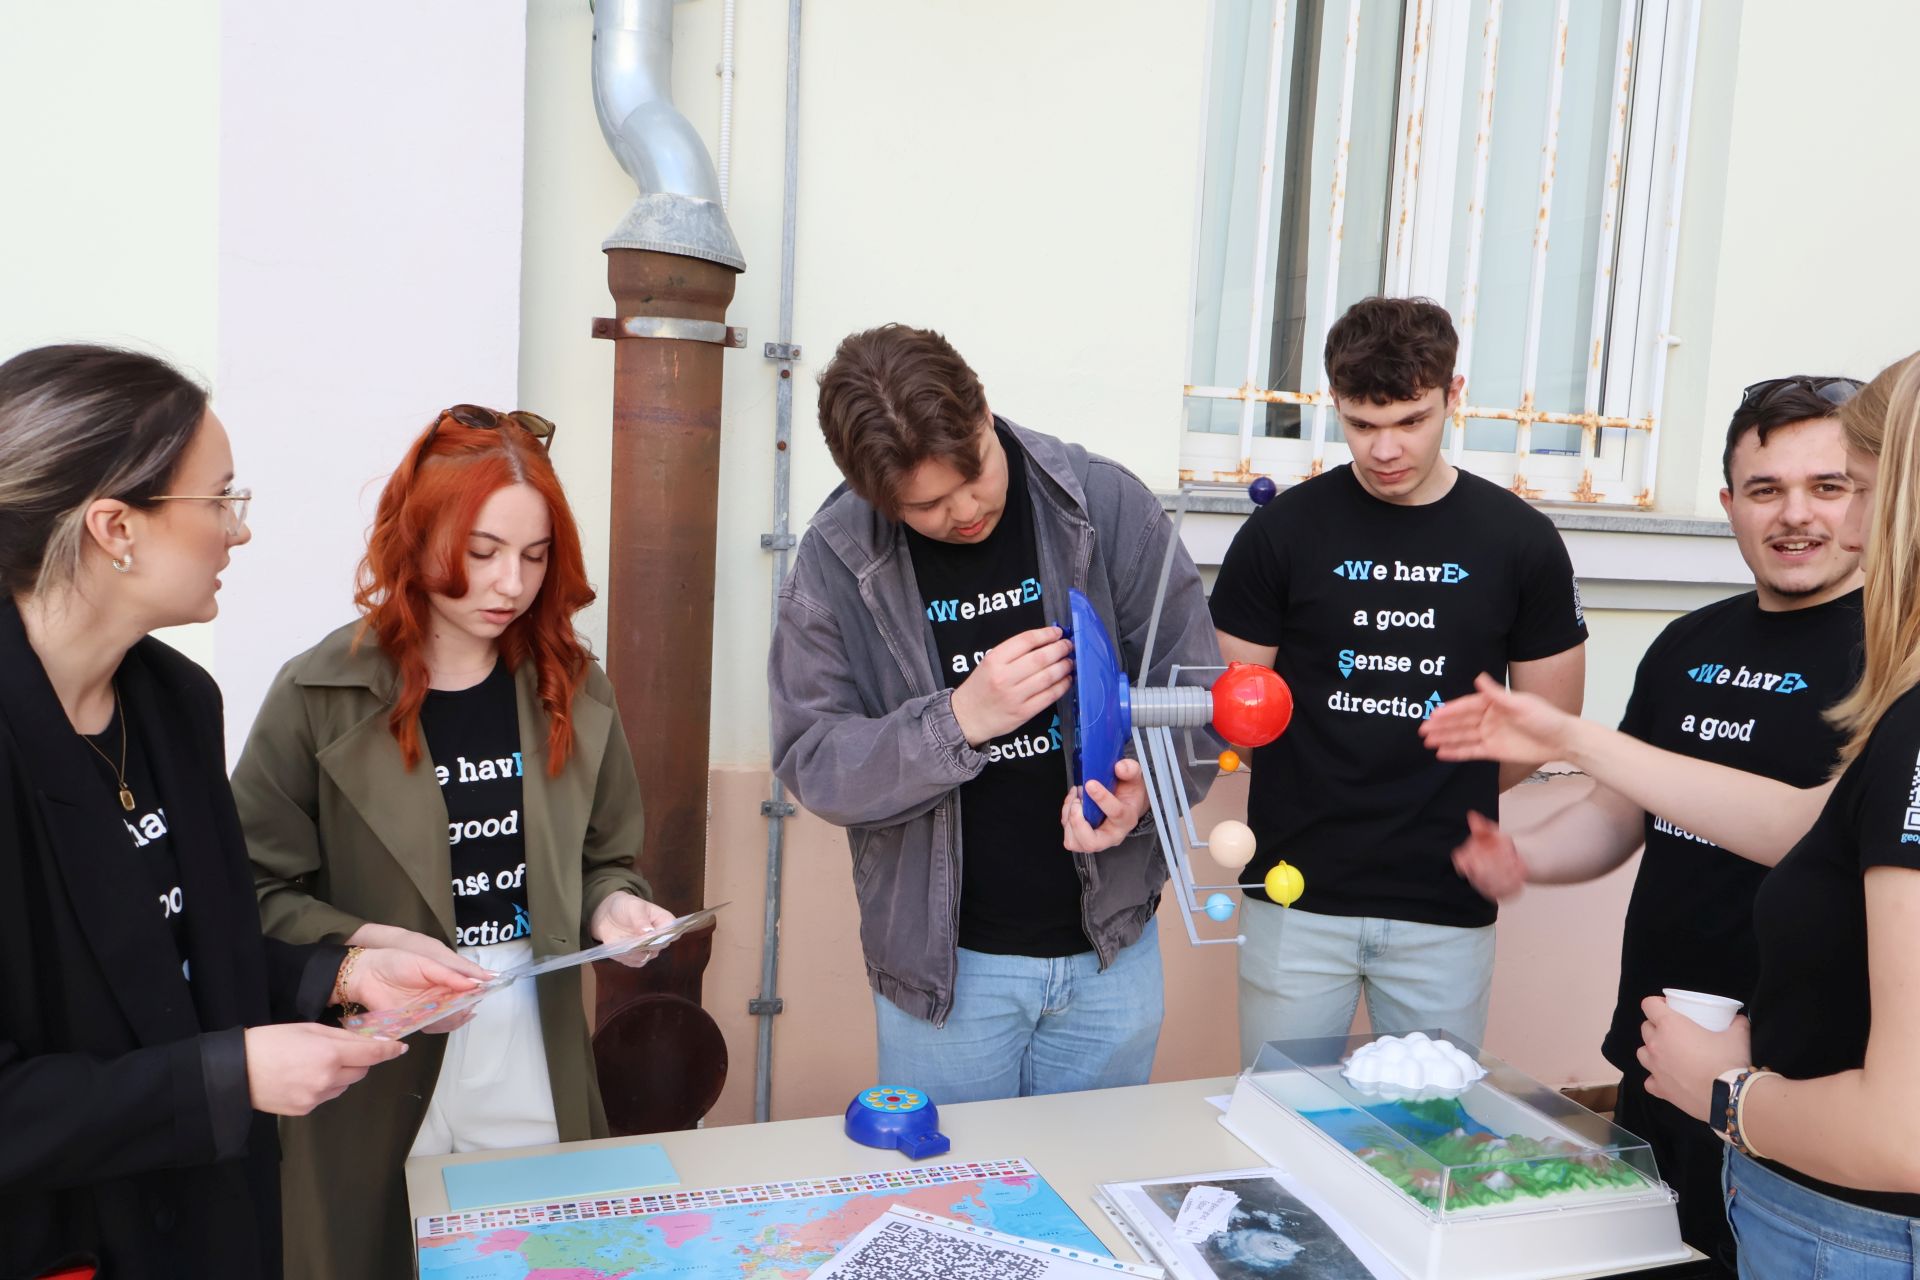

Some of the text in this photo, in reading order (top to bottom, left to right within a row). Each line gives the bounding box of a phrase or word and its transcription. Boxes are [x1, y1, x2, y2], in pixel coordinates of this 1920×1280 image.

[1344, 560, 1459, 584] We havE
[931, 577, 1039, 623] We havE
[1353, 608, 1435, 631] a good
[952, 653, 970, 673] a
[1338, 649, 1446, 676] Sense of
[1696, 663, 1801, 694] We havE
[1681, 714, 1756, 742] a good
[448, 810, 518, 845] good
[1901, 832, 1920, 845] geo
[496, 863, 526, 890] of
